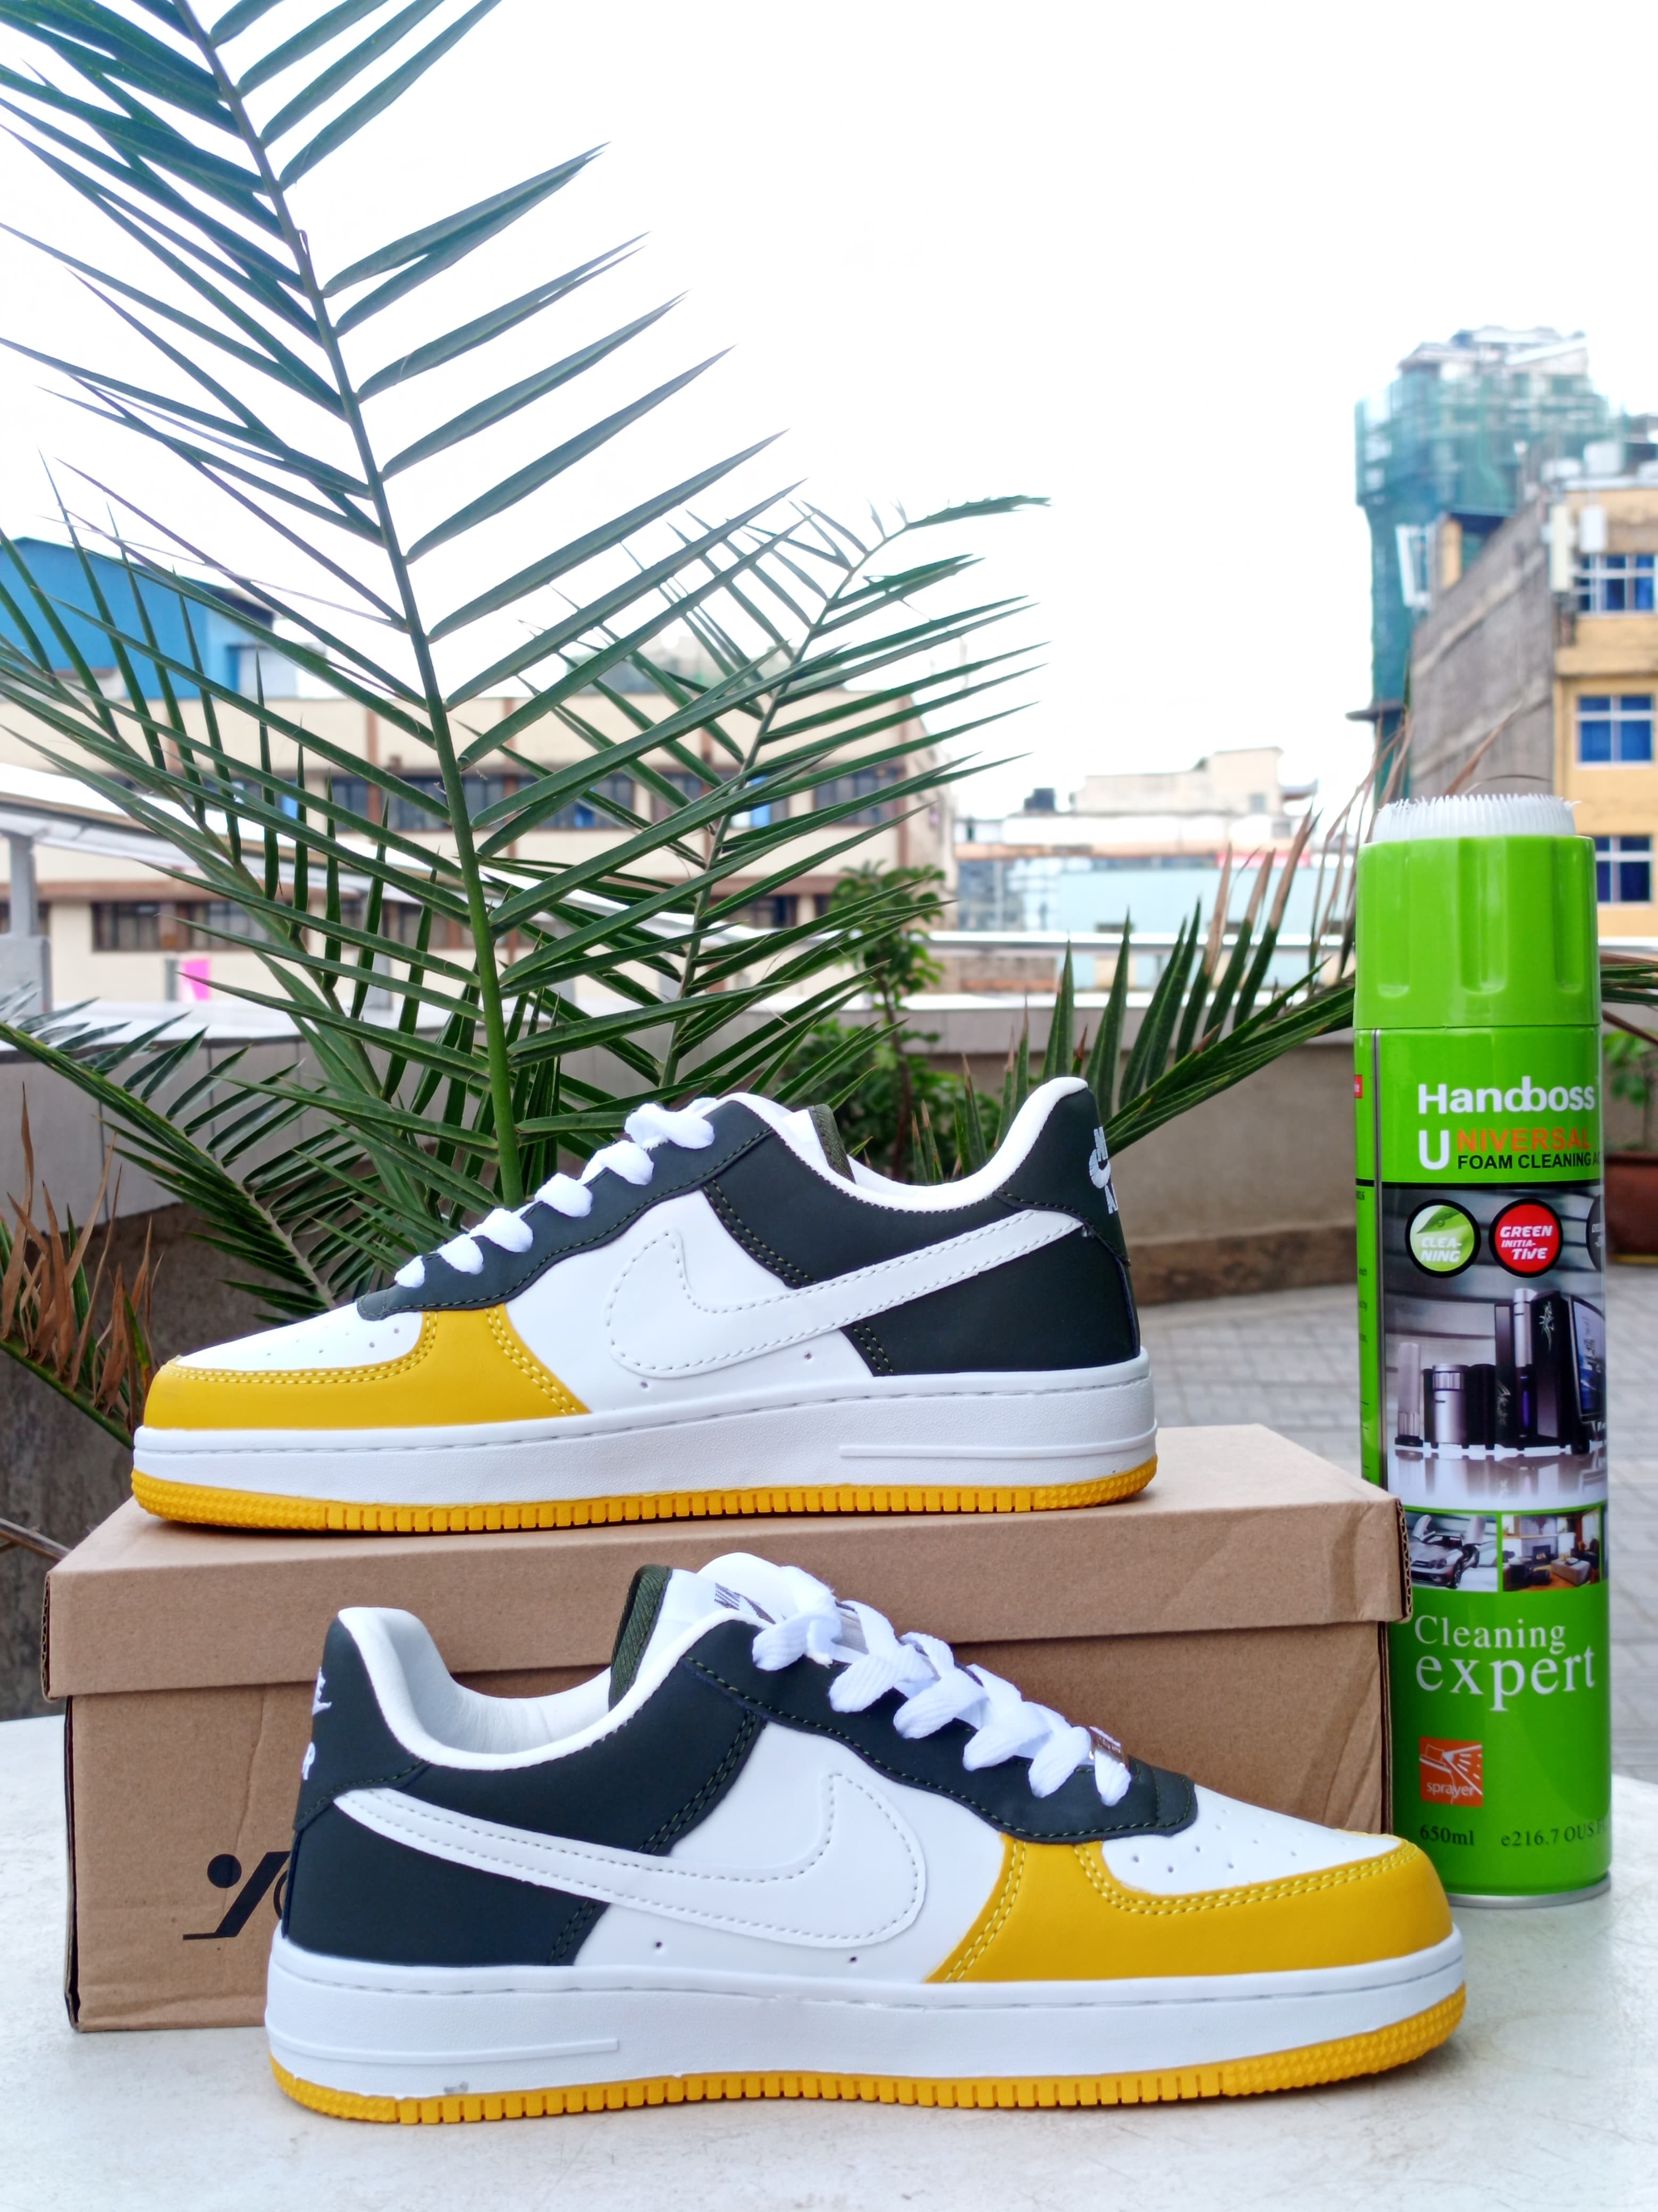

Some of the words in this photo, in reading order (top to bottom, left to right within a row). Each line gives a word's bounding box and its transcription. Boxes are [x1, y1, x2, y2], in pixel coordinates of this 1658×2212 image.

[1418, 1076, 1594, 1115] Handboss
[1458, 1154, 1513, 1169] FOAM
[1518, 1152, 1591, 1168] CLEANING
[1500, 1225, 1553, 1238] GREEN
[1501, 1239, 1536, 1248] INITIA-
[1420, 1250, 1461, 1263] NING
[1511, 1247, 1548, 1260] TIVE
[1415, 1615, 1566, 1654] Cleaning
[1415, 1646, 1595, 1712] expert
[1426, 1781, 1475, 1799] sprayer
[1419, 1824, 1475, 1846] 650ml
